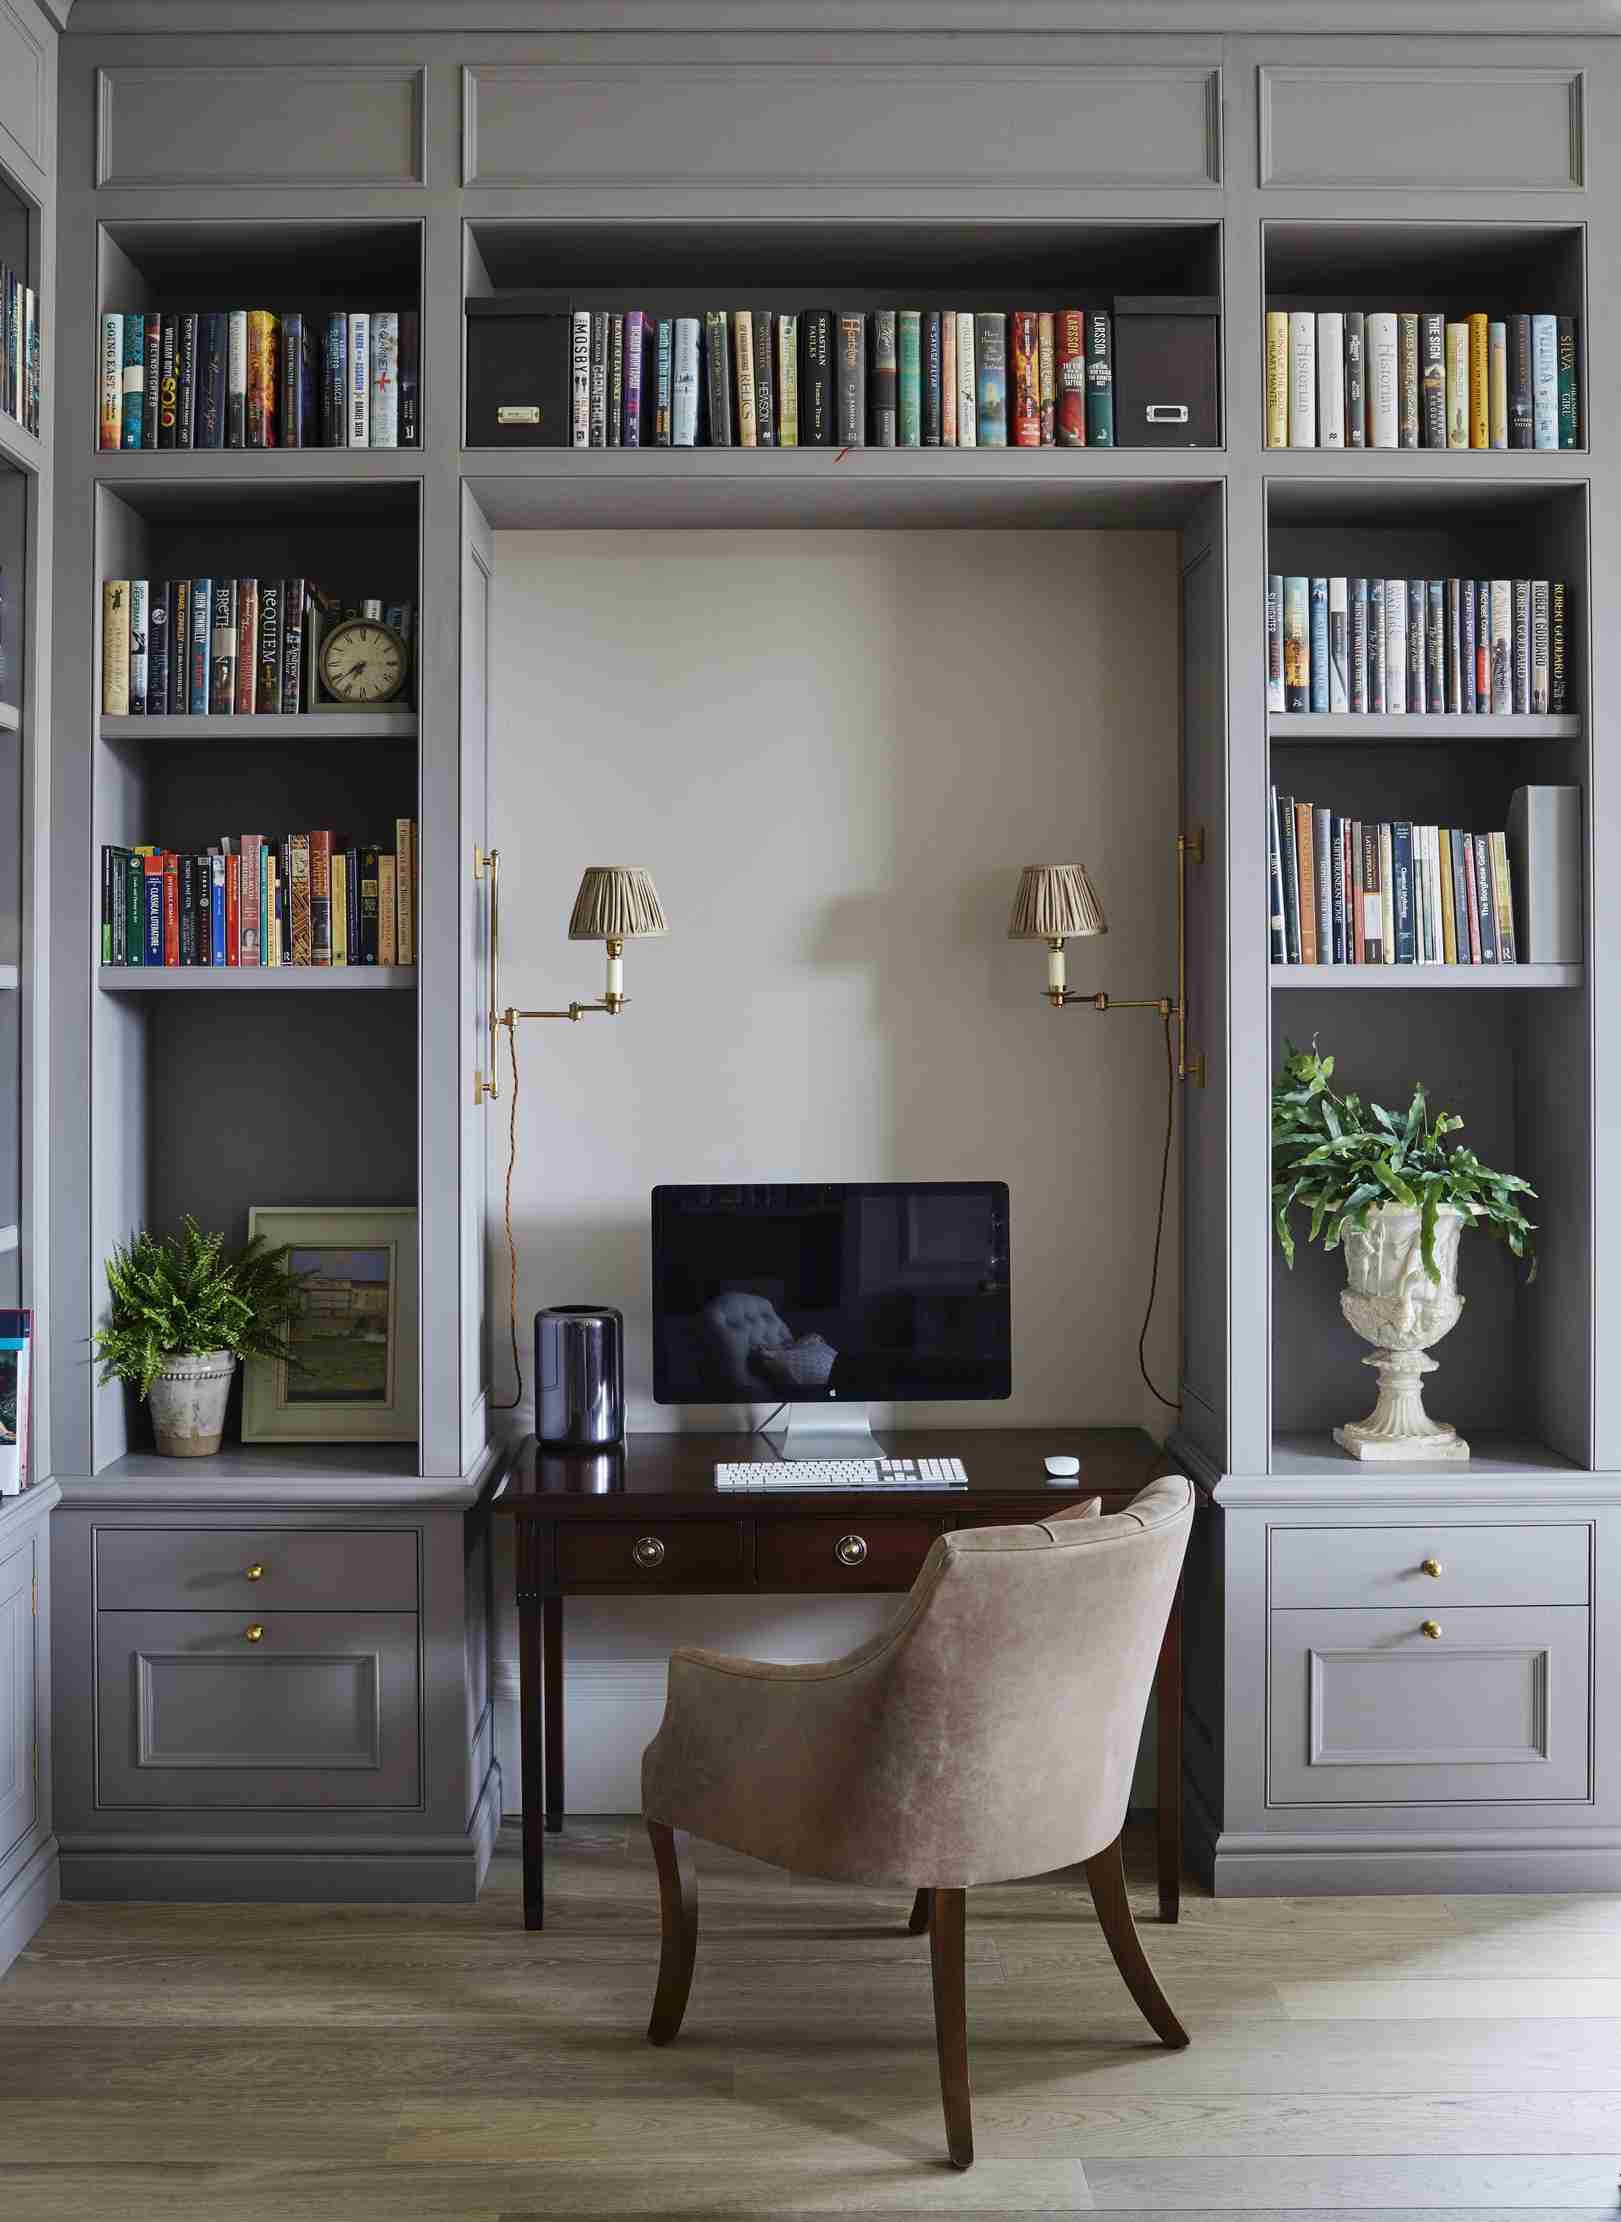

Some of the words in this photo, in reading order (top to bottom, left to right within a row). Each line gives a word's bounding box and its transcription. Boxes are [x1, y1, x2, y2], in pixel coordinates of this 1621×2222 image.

[106, 321, 117, 357] GOING
[613, 319, 622, 346] DEATH
[659, 323, 670, 348] death
[808, 325, 817, 359] FAULKS
[818, 317, 826, 366] SEBASTIAN
[1066, 314, 1080, 355] LARSSON
[1094, 316, 1106, 355] LARSSON
[1429, 316, 1441, 335] THE
[164, 327, 174, 359] WILLIAM
[574, 323, 588, 373] MOSBY
[1429, 336, 1441, 360] SIGN
[1560, 335, 1571, 371] SILVA
[106, 360, 117, 388] EAST
[659, 362, 670, 376] the
[1296, 343, 1313, 417] Historian
[1378, 343, 1394, 416] Historian
[161, 376, 176, 428] SOLO
[591, 365, 603, 429] GARNETHILL
[741, 373, 753, 420] RELICS
[759, 381, 769, 423] HEWSON
[1269, 374, 1278, 409] MANTEL
[1561, 392, 1570, 418] GIRL
[354, 401, 364, 421] DANIEL
[354, 422, 364, 438] SILVA
[194, 591, 208, 609] JOHN
[1480, 588, 1490, 617] Michael
[1516, 583, 1529, 621] ROBERT
[1535, 585, 1547, 619] ROBERT
[1554, 583, 1565, 622] ROBERT
[193, 611, 208, 643] CONNOLLY
[291, 646, 299, 676] Andrew
[1515, 624, 1527, 679] GODDARD
[1535, 622, 1547, 667] GODDARD
[1554, 625, 1564, 678] GODDARD
[1479, 867, 1488, 901] Borghese
[150, 887, 160, 916] CLASSICAL
[1481, 901, 1490, 917] The
[150, 917, 160, 947] LITERATURE
